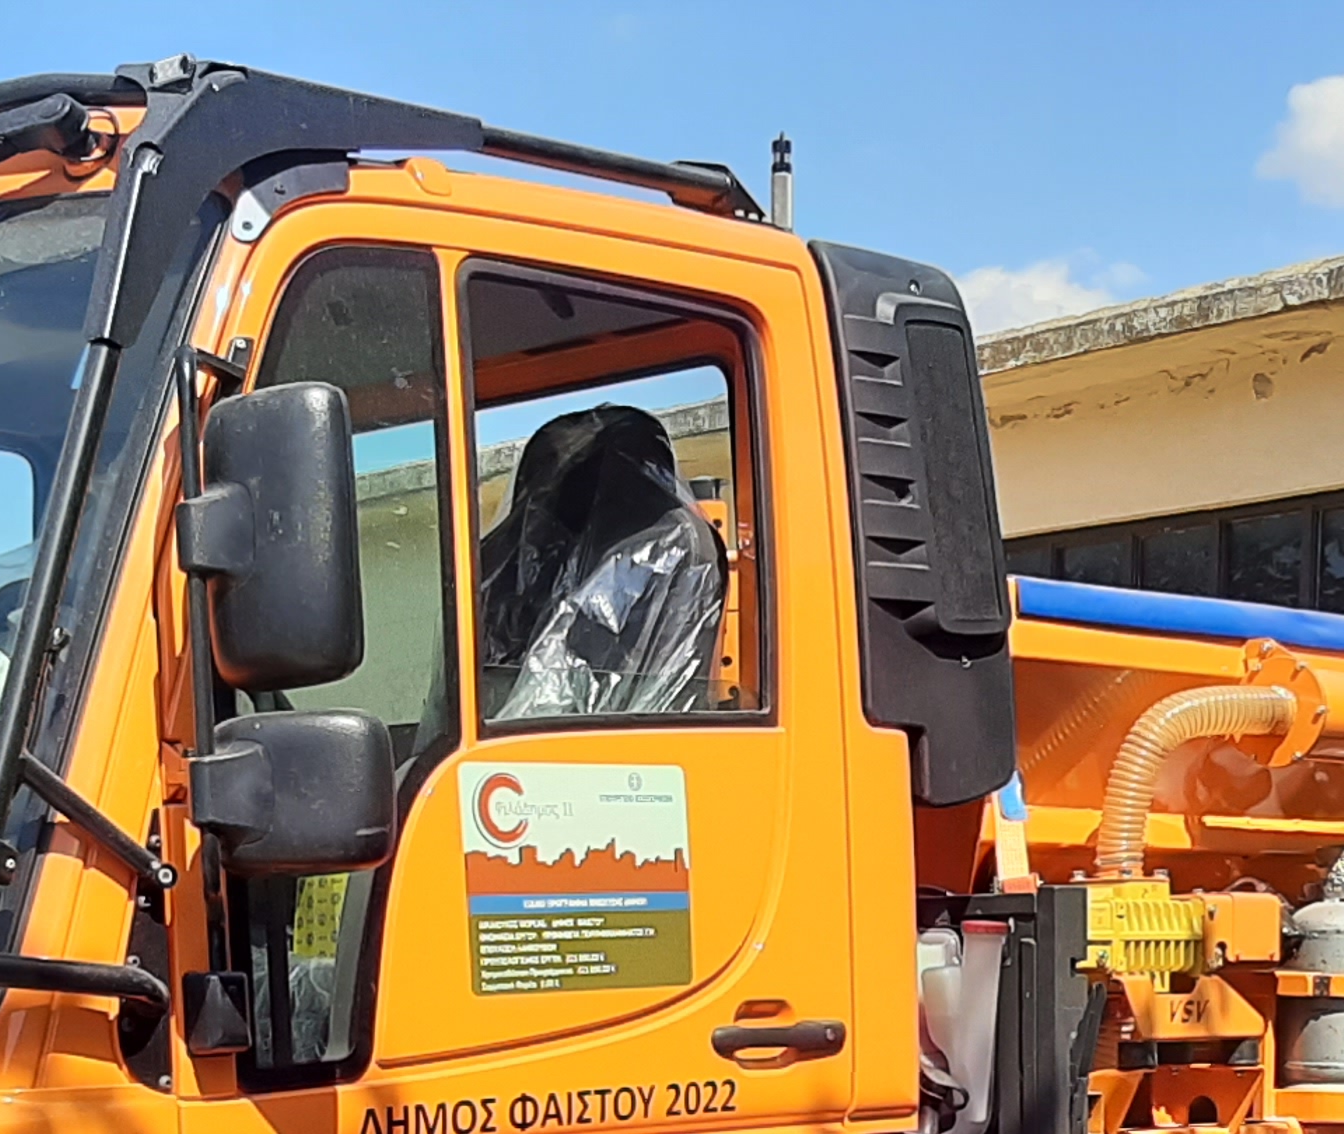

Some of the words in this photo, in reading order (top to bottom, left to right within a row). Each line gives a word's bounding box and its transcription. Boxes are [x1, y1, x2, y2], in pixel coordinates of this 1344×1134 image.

[1169, 999, 1210, 1024] VSV
[508, 1084, 656, 1133] ΦΑΙΣΤΟΥ
[665, 1078, 738, 1118] 2022
